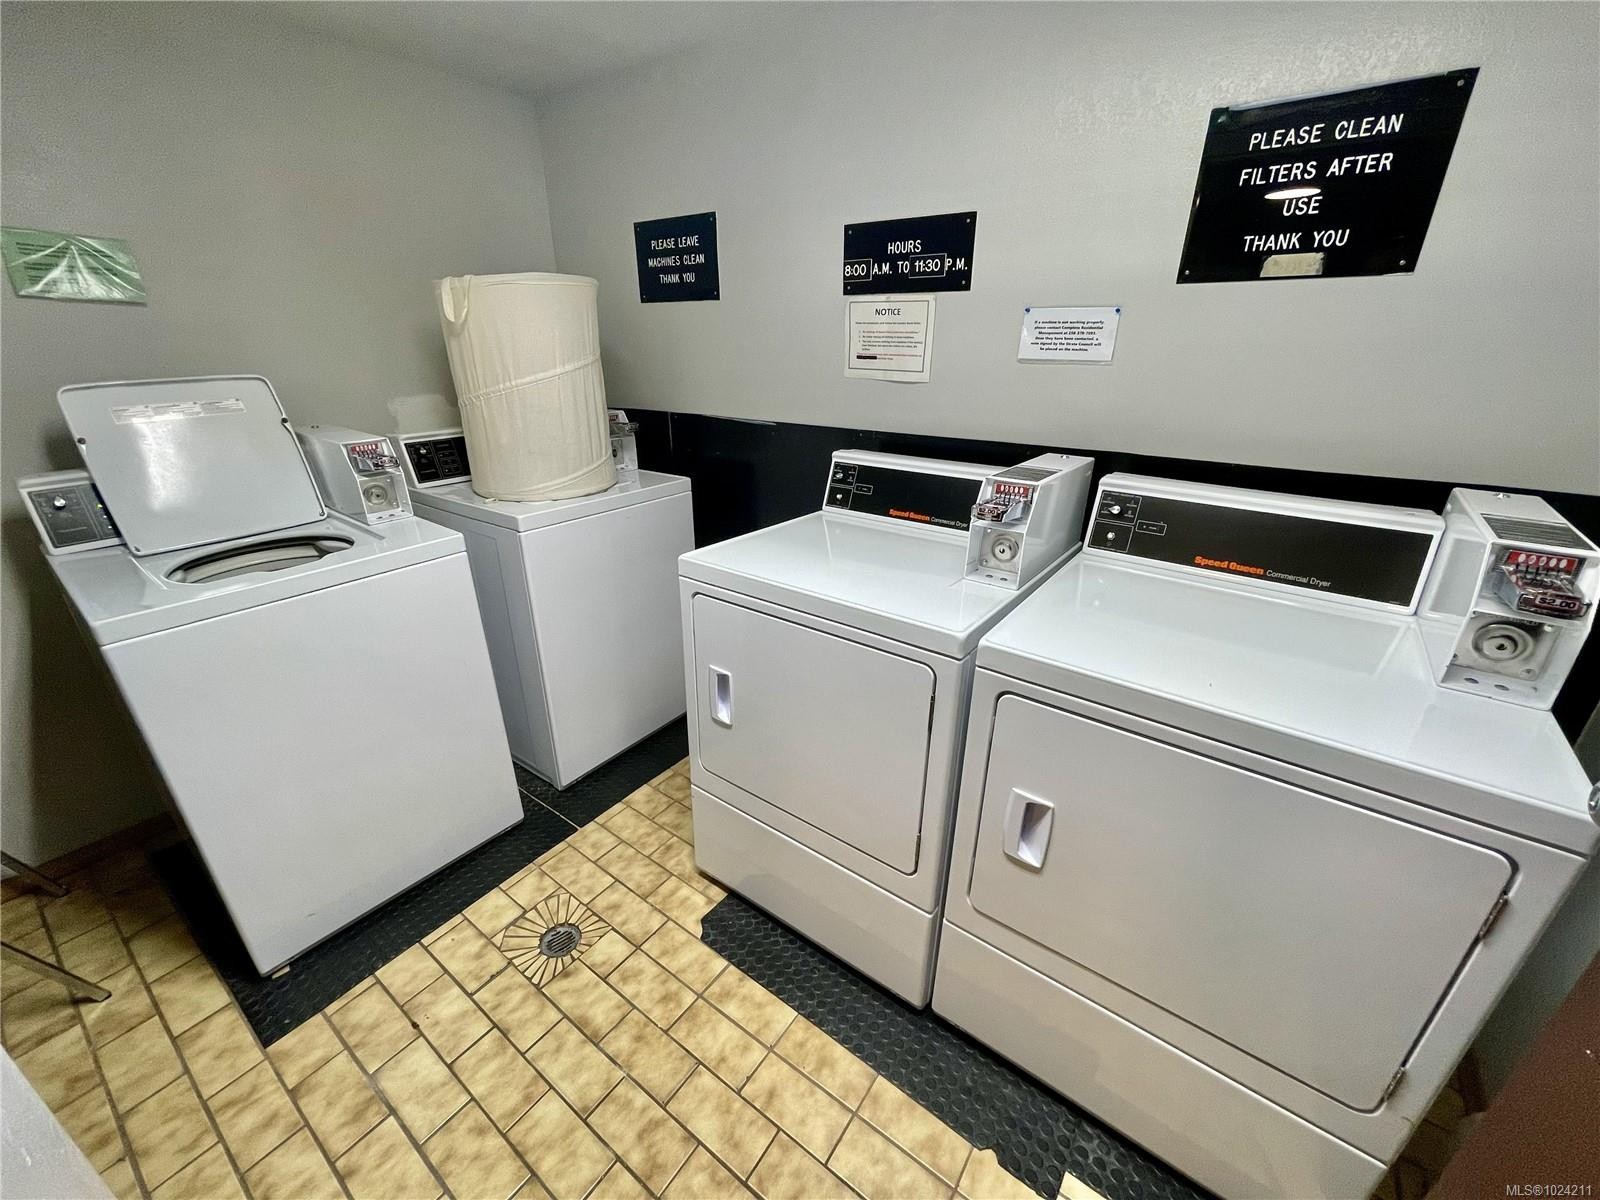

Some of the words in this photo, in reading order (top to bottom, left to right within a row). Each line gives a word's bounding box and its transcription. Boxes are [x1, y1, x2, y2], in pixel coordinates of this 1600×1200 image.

[1248, 123, 1326, 151] PLEASE
[1335, 113, 1404, 141] CLEAN
[1239, 161, 1317, 187] FILTERS
[1326, 152, 1394, 178] AFTER
[1282, 195, 1323, 217] USE
[651, 238, 675, 250] PLEASE
[678, 235, 700, 248] LEAVE
[887, 240, 922, 254] HOURS
[1243, 232, 1301, 253] THANK
[1313, 228, 1351, 248] YOU
[648, 255, 680, 268] MACHINES
[683, 253, 705, 265] CLEAN
[844, 264, 867, 276] 8:00
[872, 262, 893, 275] A.M.
[897, 261, 910, 273] TO
[914, 258, 941, 272] 11:30
[945, 257, 968, 271] P.M.
[659, 273, 680, 284] THANK
[682, 272, 695, 283] YOU
[874, 308, 902, 316] NOTICE
[889, 508, 909, 518] Speed
[909, 512, 930, 521] Queen
[930, 516, 956, 526] Commercial
[1194, 556, 1229, 570] Speed
[1229, 561, 1265, 575] Queen
[1266, 569, 1309, 584] Commercial
[1310, 577, 1332, 588] Dryer
[1538, 597, 1577, 609] $2.00
